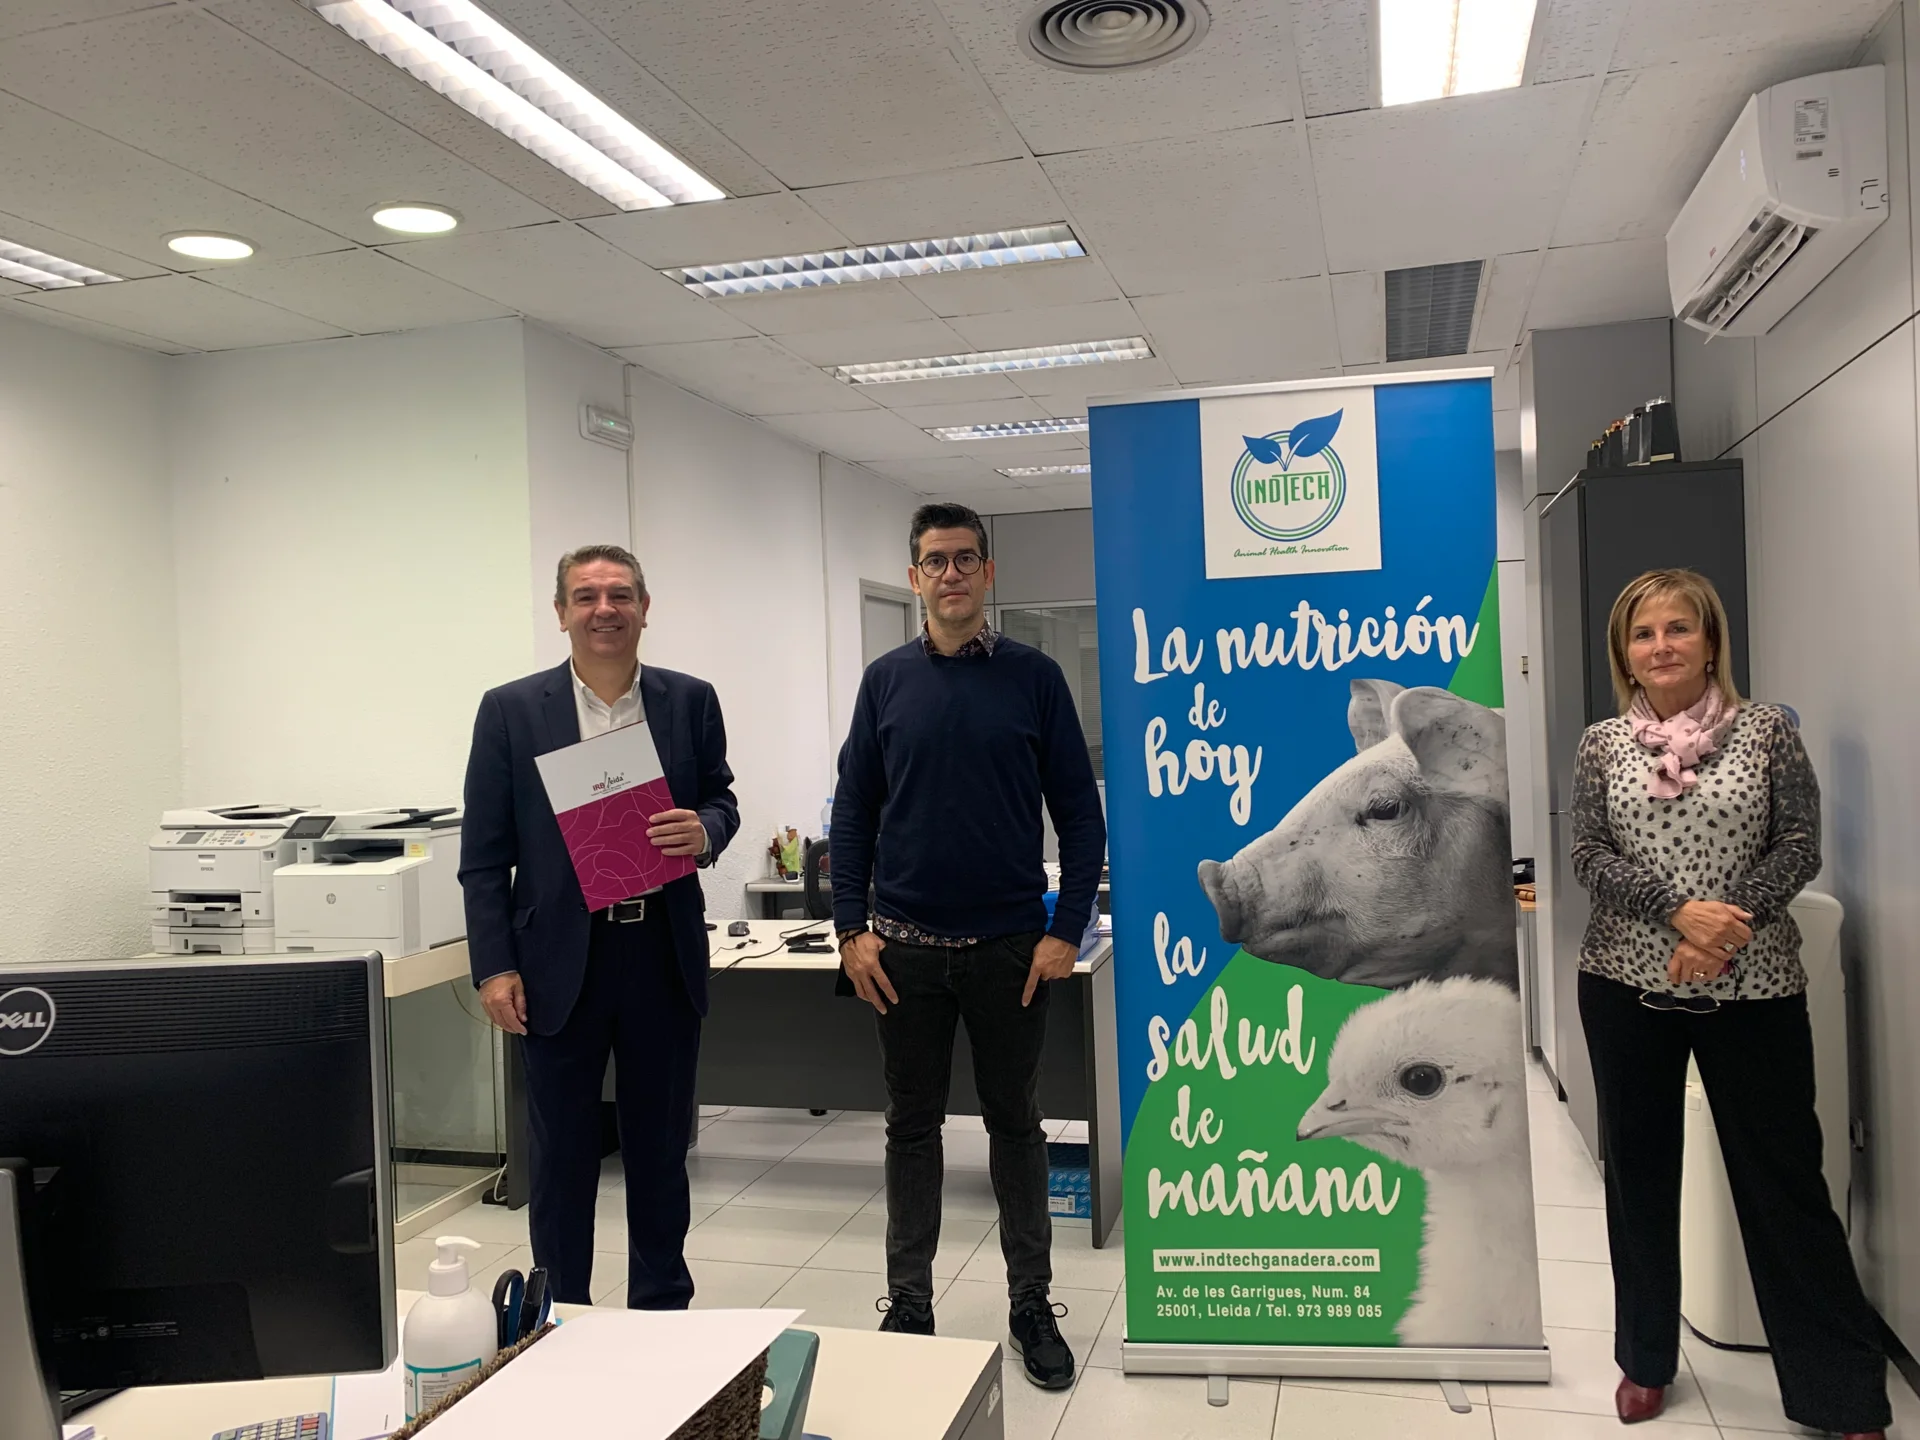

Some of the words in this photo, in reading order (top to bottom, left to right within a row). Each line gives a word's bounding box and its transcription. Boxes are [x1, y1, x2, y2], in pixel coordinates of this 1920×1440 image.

[1246, 471, 1330, 506] INDTECH
[1233, 547, 1268, 558] Animal
[1269, 546, 1298, 556] Health
[1301, 544, 1350, 555] Innovation
[1133, 607, 1204, 683] La
[1217, 595, 1480, 673] nutrición
[1188, 682, 1227, 731] de
[1145, 716, 1263, 826] hoy
[1153, 911, 1207, 985] la
[1146, 984, 1316, 1082] salud
[1170, 1085, 1224, 1149] de
[1147, 1149, 1401, 1219] mañana
[1158, 1252, 1375, 1270] www.indtechganadera.com
[1156, 1285, 1177, 1298] Av.
[1182, 1285, 1200, 1298] de
[1204, 1285, 1225, 1298] les
[1230, 1285, 1307, 1301] Garrigues,
[1311, 1285, 1348, 1298] Num.
[1353, 1285, 1371, 1298] 84
[1156, 1304, 1202, 1319] 25001,
[1207, 1304, 1251, 1317] Lleida
[1255, 1304, 1262, 1317] /
[1265, 1304, 1292, 1317] Tel.
[1296, 1304, 1322, 1317] 973
[1327, 1304, 1352, 1317] 989
[1357, 1304, 1383, 1317] 085
